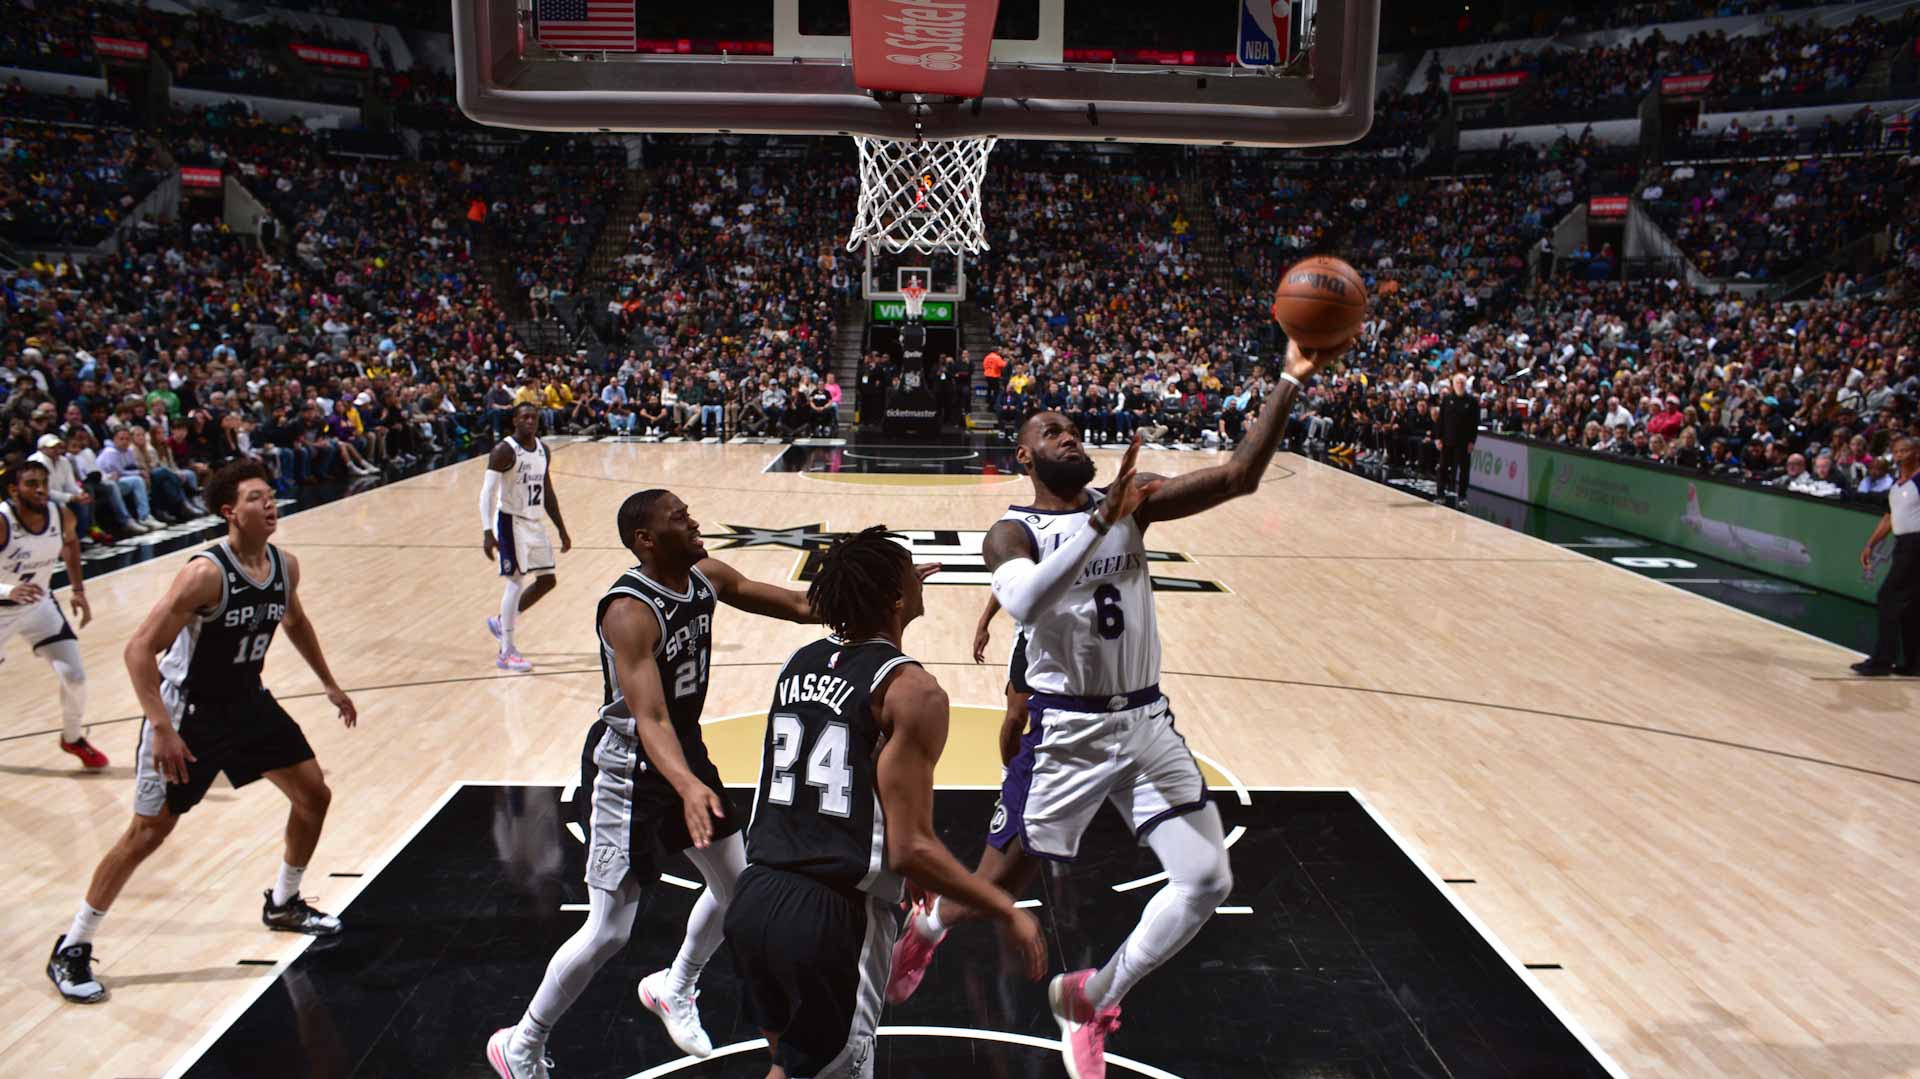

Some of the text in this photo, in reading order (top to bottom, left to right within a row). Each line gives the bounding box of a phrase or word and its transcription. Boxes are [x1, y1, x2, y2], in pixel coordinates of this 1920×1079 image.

[1245, 40, 1270, 60] NBA
[887, 409, 937, 418] ticketmaster
[528, 484, 542, 507] 12
[1075, 553, 1142, 586] NGELES
[654, 597, 666, 609] 6
[1093, 583, 1125, 640] 6
[233, 633, 270, 664] 18
[779, 672, 855, 716] VASSELL
[767, 713, 853, 818] 24
